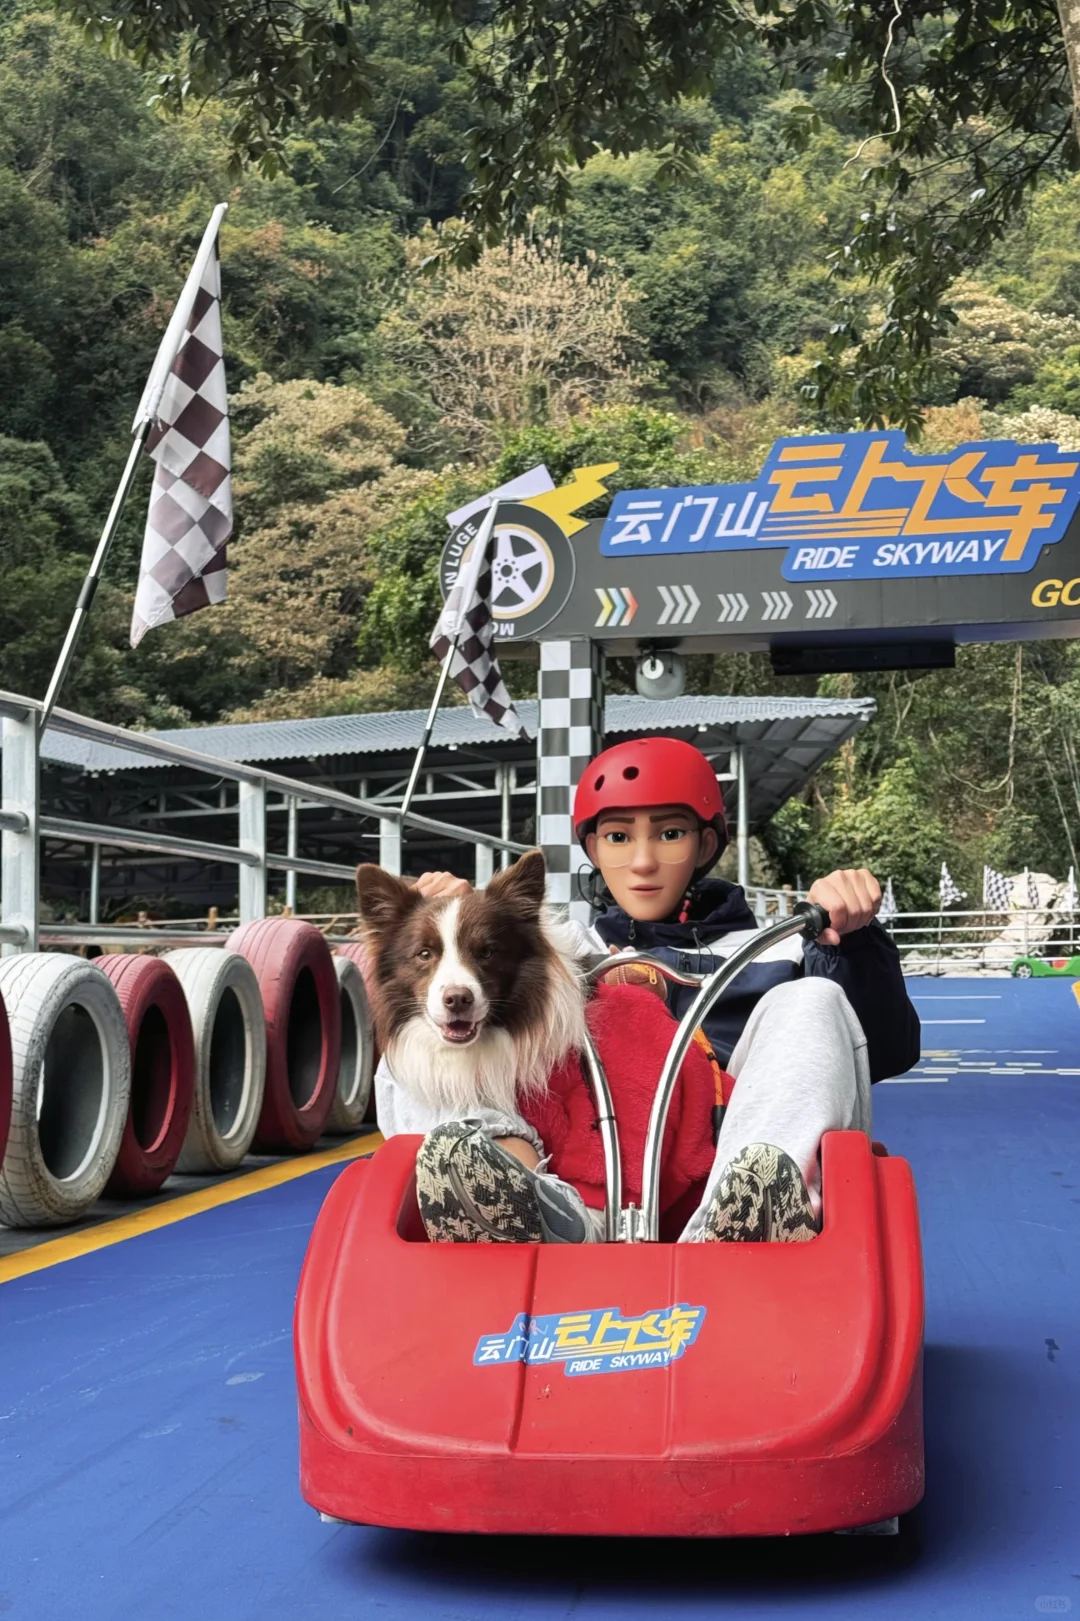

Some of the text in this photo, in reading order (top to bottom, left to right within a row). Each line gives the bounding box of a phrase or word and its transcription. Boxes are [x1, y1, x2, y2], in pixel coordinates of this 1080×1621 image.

[610, 441, 1079, 561] 云门山 云上飞车
[445, 522, 478, 567] LUGE
[792, 538, 1005, 570] RIDE SKYWAY
[478, 1307, 700, 1362] 云门山 云上飞车
[569, 1351, 671, 1373] RIDE SKYWAY
